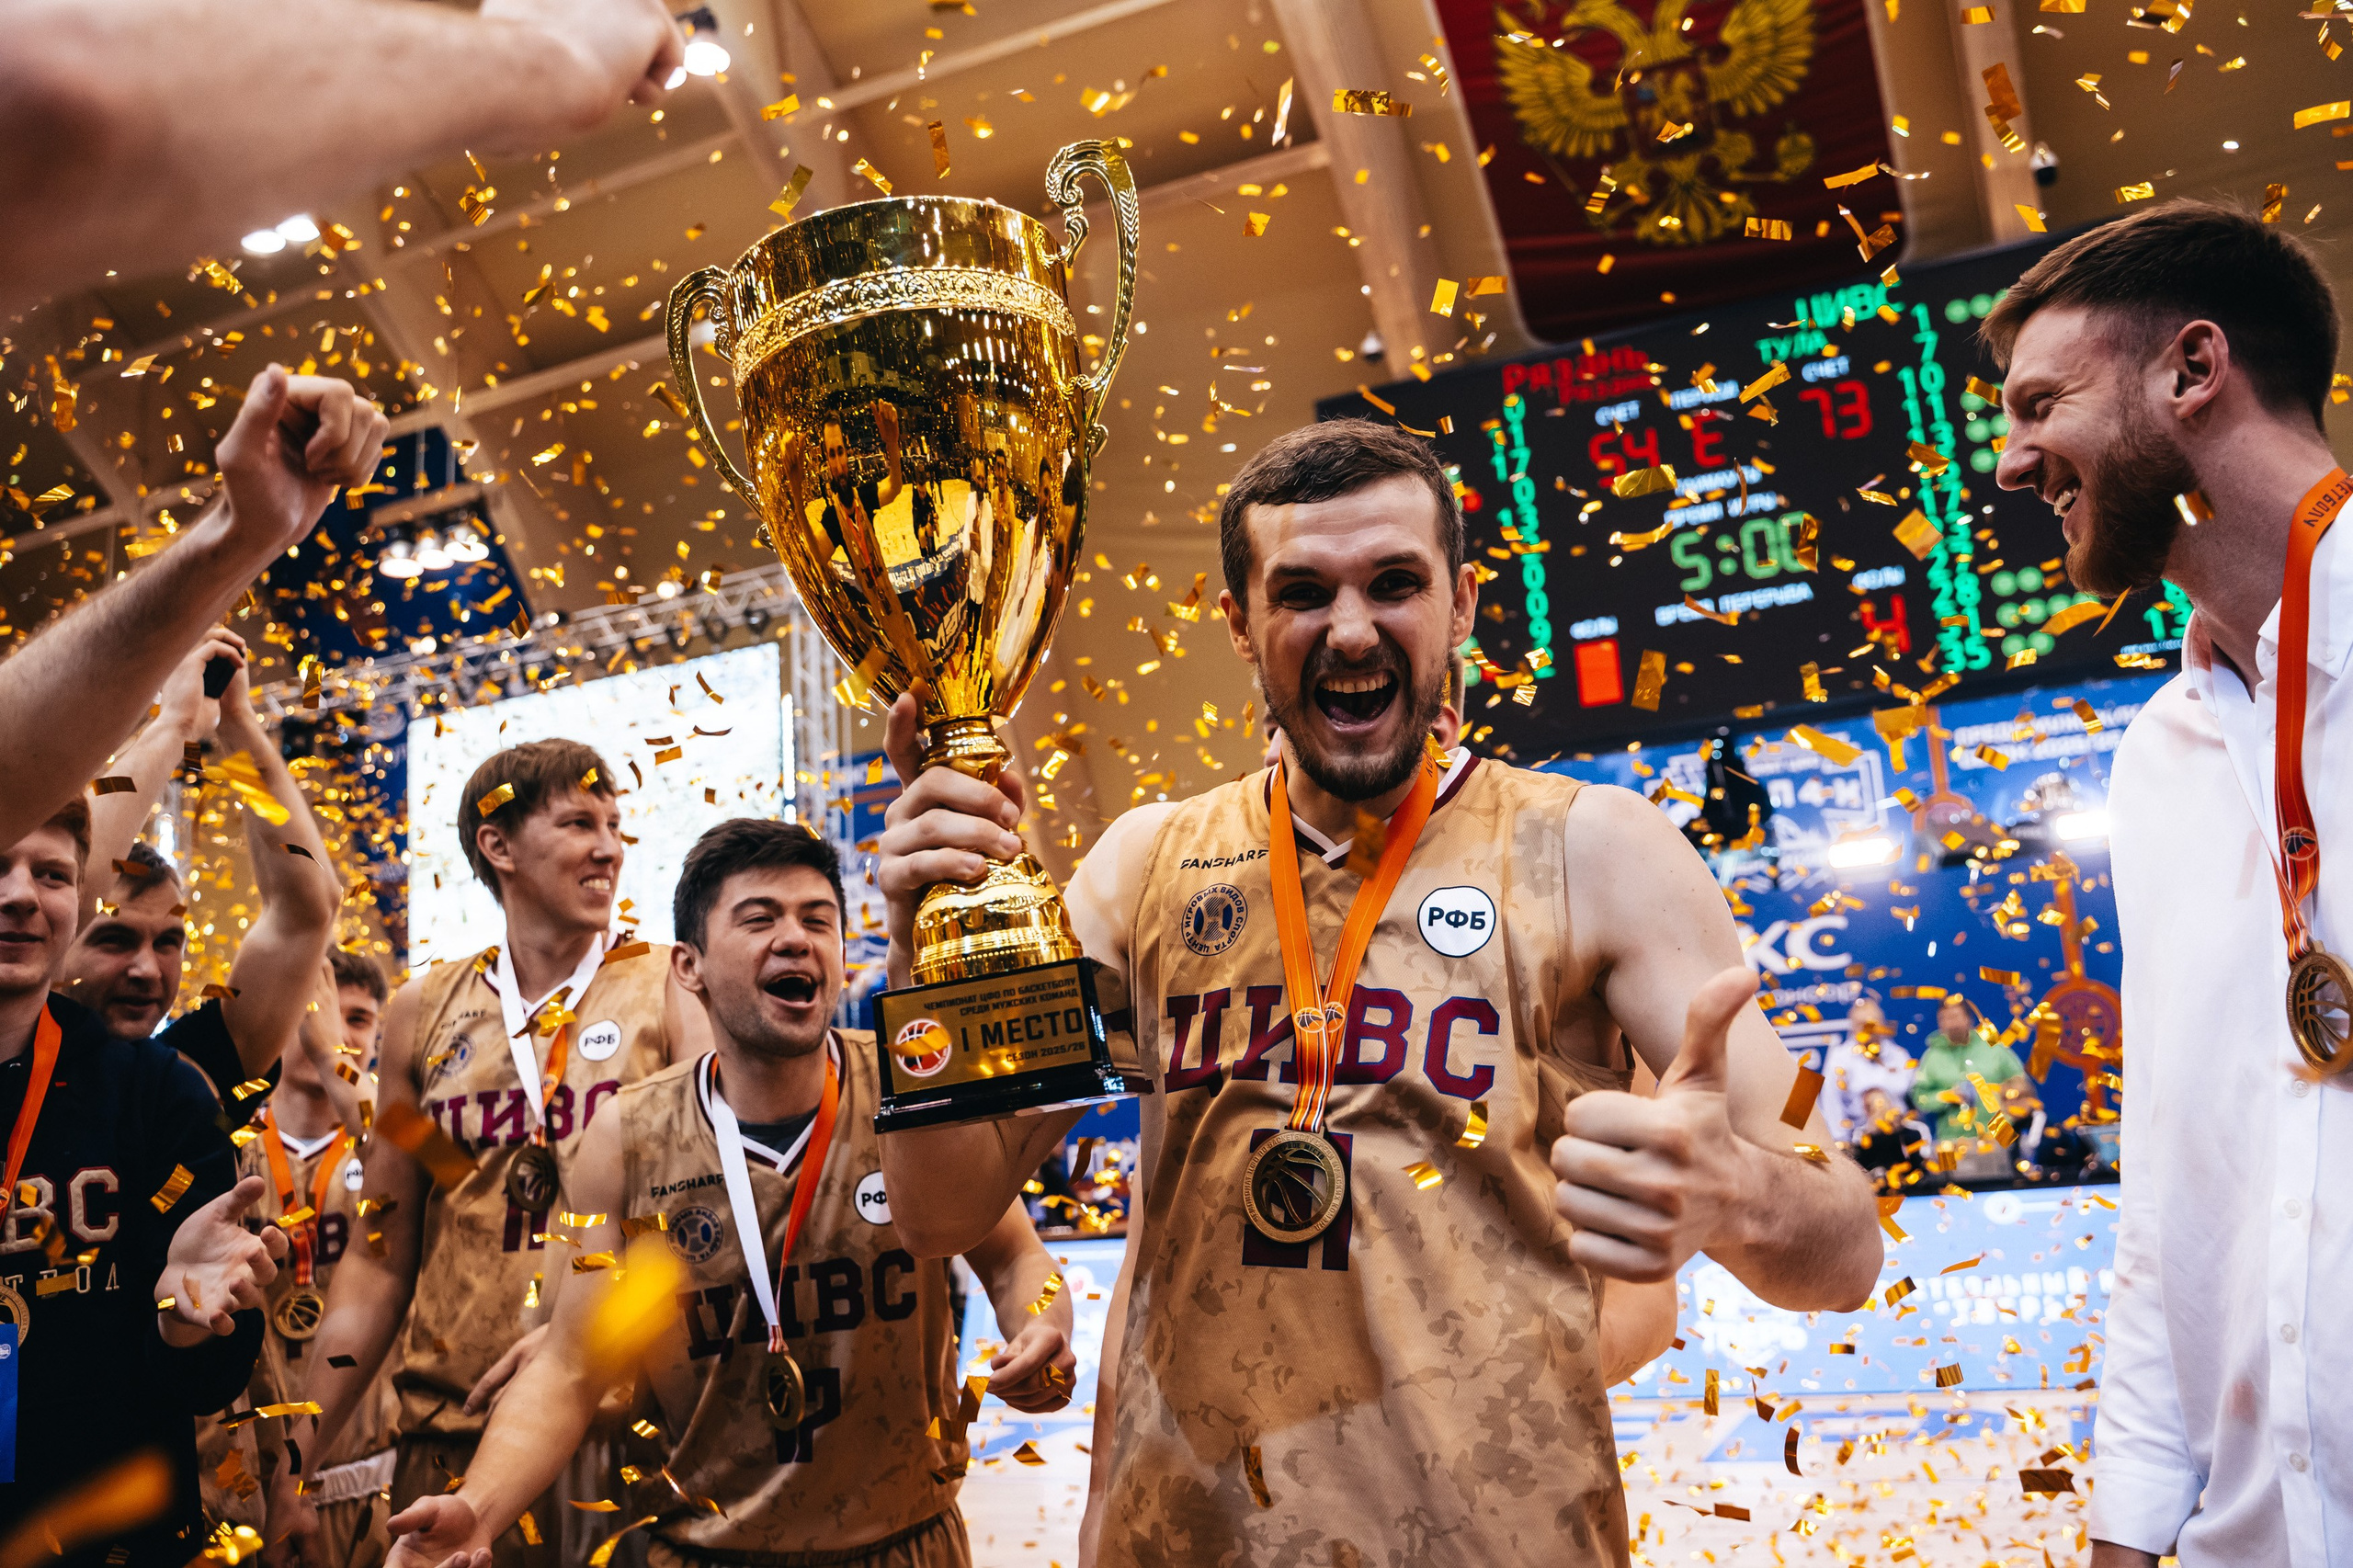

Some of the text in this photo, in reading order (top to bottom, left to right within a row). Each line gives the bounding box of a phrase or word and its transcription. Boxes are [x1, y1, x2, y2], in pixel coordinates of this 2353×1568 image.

[1798, 380, 1873, 438] 73
[1588, 427, 1661, 488] 54
[1689, 410, 1726, 468] E
[1670, 510, 1820, 592] 5:00
[1859, 594, 1911, 653] 4
[1185, 887, 1244, 953] ЦЕНТР ИГРОВЫХ ВИДОВ СПОРТА
[1427, 906, 1486, 930] РФБ
[924, 977, 1076, 1011] ЧЕМПИОНАТ ЦФО ПО БАСКЕТБОЛУ
[960, 987, 1078, 1017] СРЕДИ МУЖСКИХ КОМАНД
[585, 1033, 616, 1048] РФБ
[981, 1007, 1084, 1049] МЕСТО
[1164, 983, 1500, 1101] ЦИВС
[1006, 1050, 1038, 1062] СЕЗОН
[861, 1192, 887, 1207] РФ
